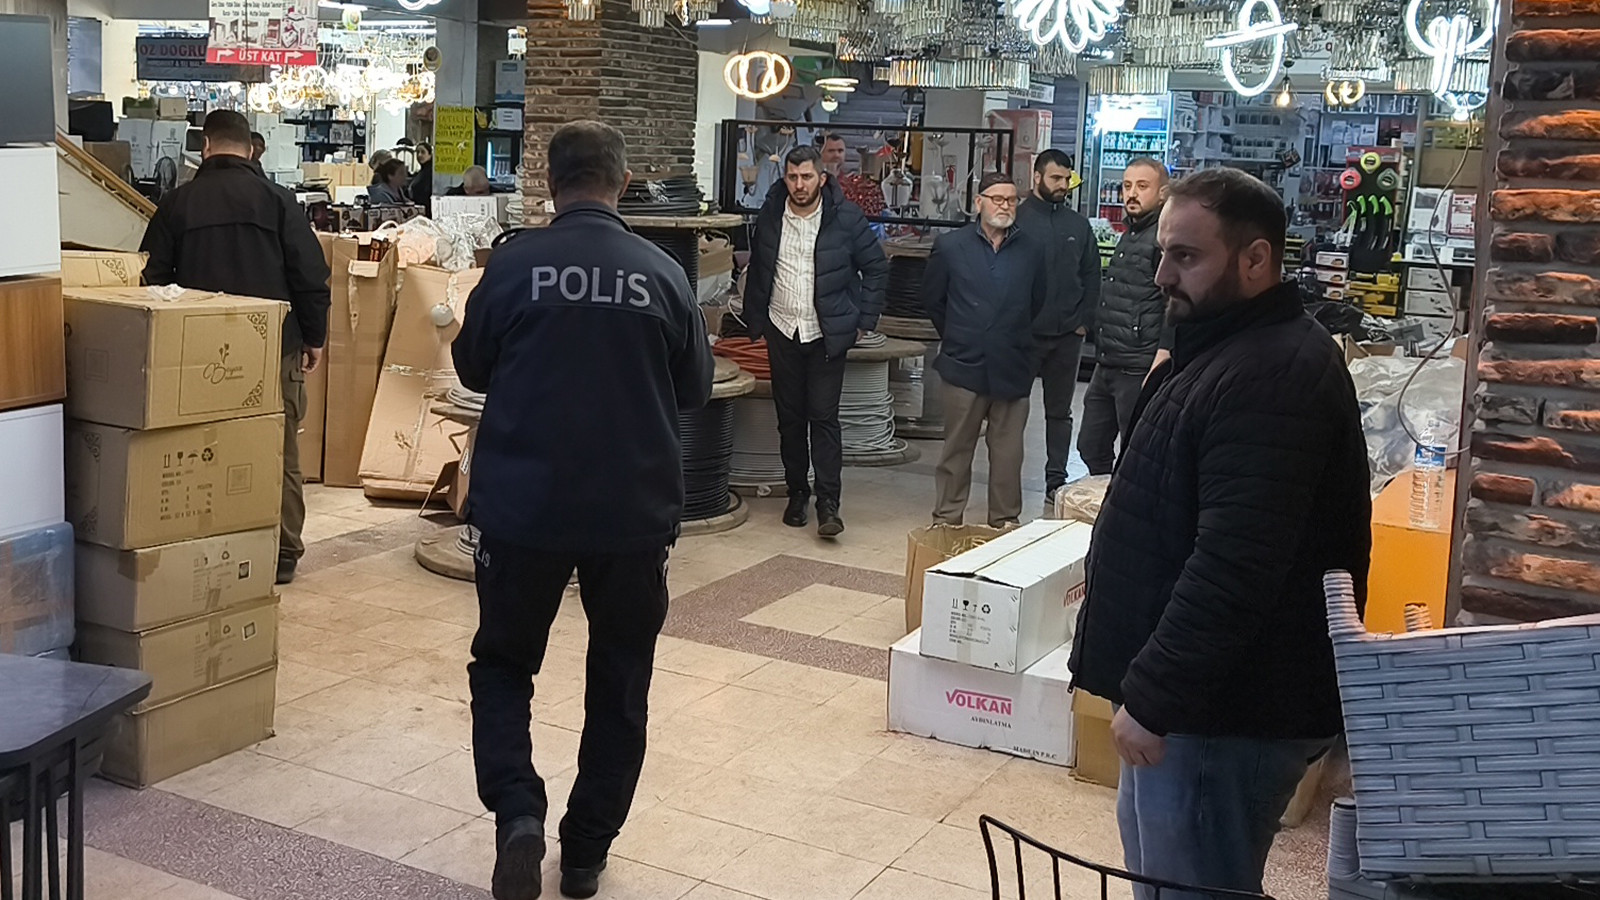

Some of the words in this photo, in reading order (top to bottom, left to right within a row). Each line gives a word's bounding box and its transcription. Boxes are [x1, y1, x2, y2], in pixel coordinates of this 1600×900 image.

[238, 47, 260, 62] ÜST
[260, 51, 282, 63] KAT
[945, 688, 1013, 716] VOLKAN
[970, 716, 1012, 729] AYDINLATMA
